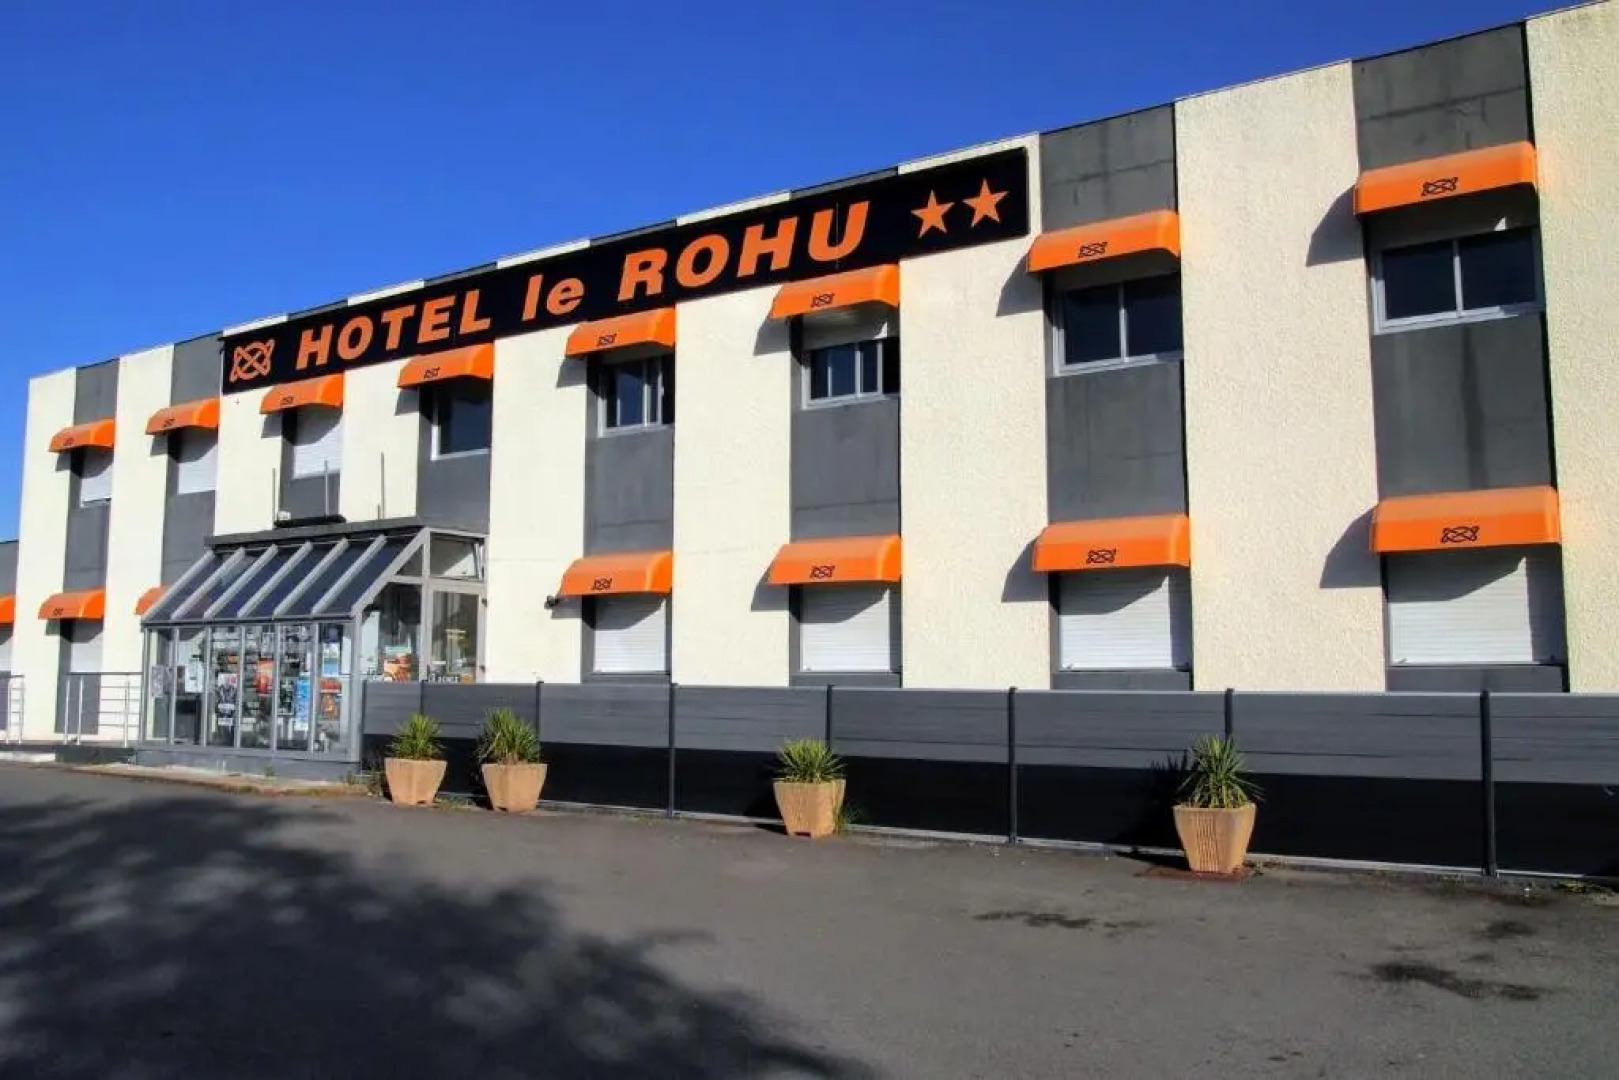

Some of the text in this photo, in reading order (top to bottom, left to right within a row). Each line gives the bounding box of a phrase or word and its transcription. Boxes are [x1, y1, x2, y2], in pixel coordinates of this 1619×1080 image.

[296, 200, 870, 371] HOTEL le ROHU
